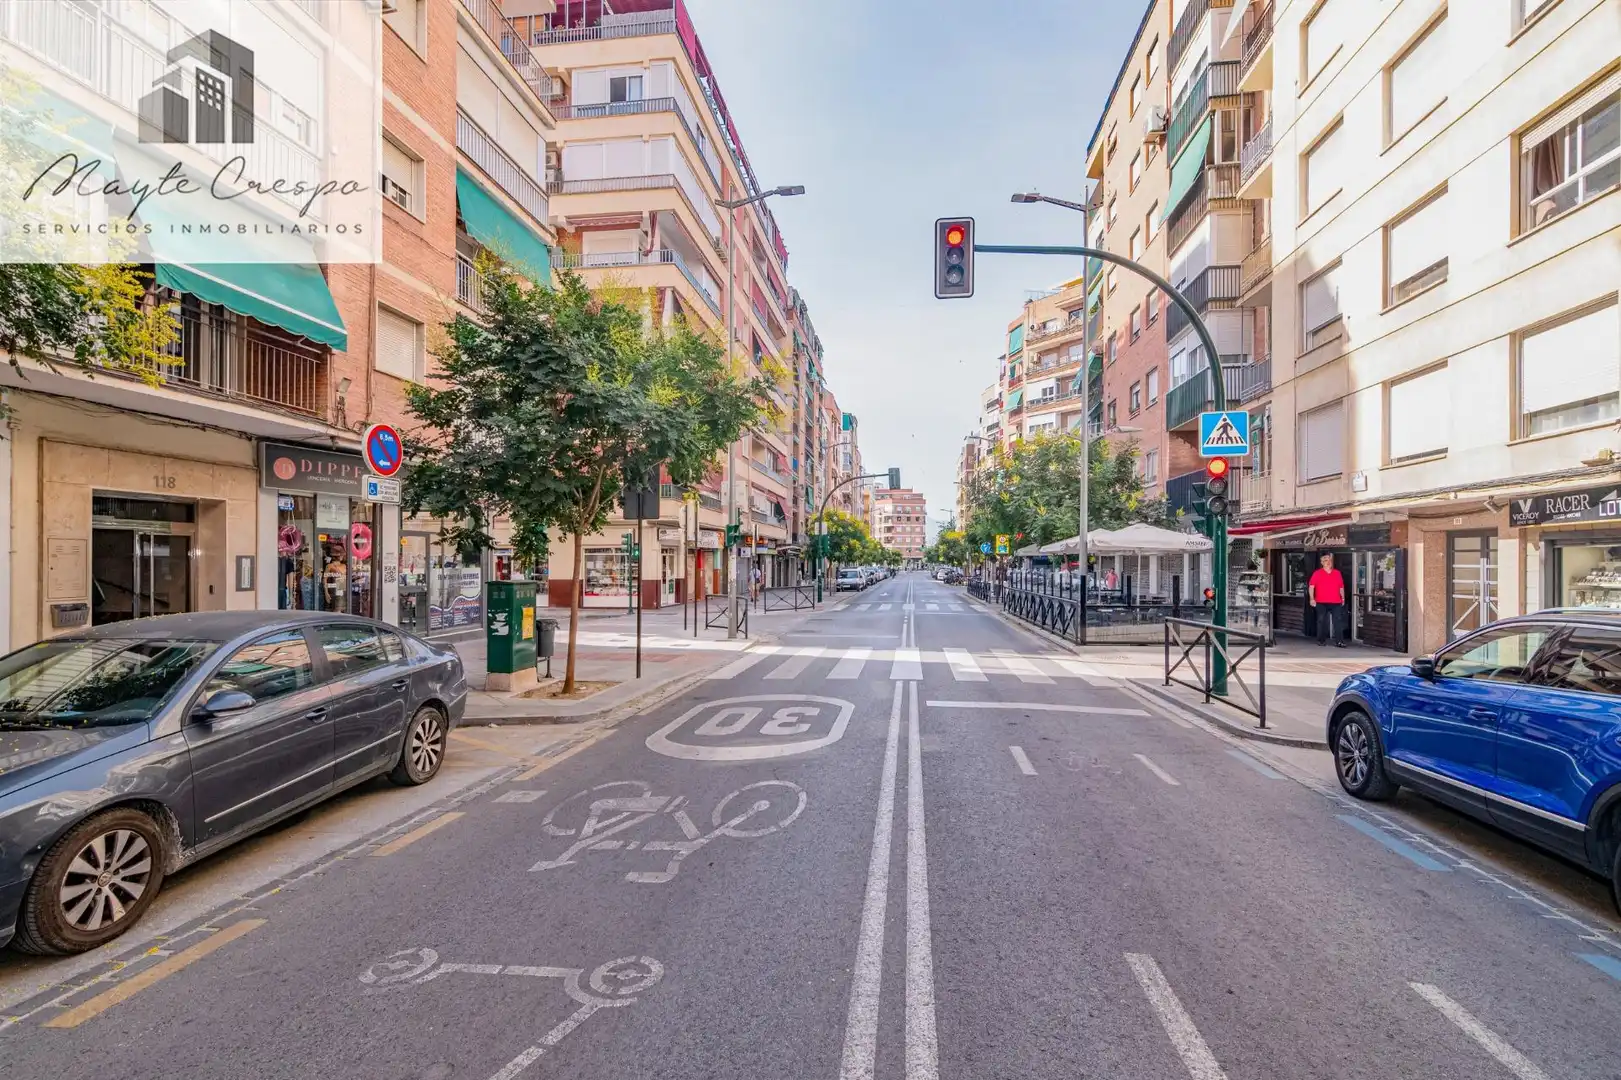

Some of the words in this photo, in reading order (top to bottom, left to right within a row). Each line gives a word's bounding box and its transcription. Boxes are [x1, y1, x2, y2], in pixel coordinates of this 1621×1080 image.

[153, 475, 177, 489] 118
[1545, 493, 1591, 514] RACER
[1512, 511, 1540, 520] VICEROY
[694, 707, 820, 735] 30
